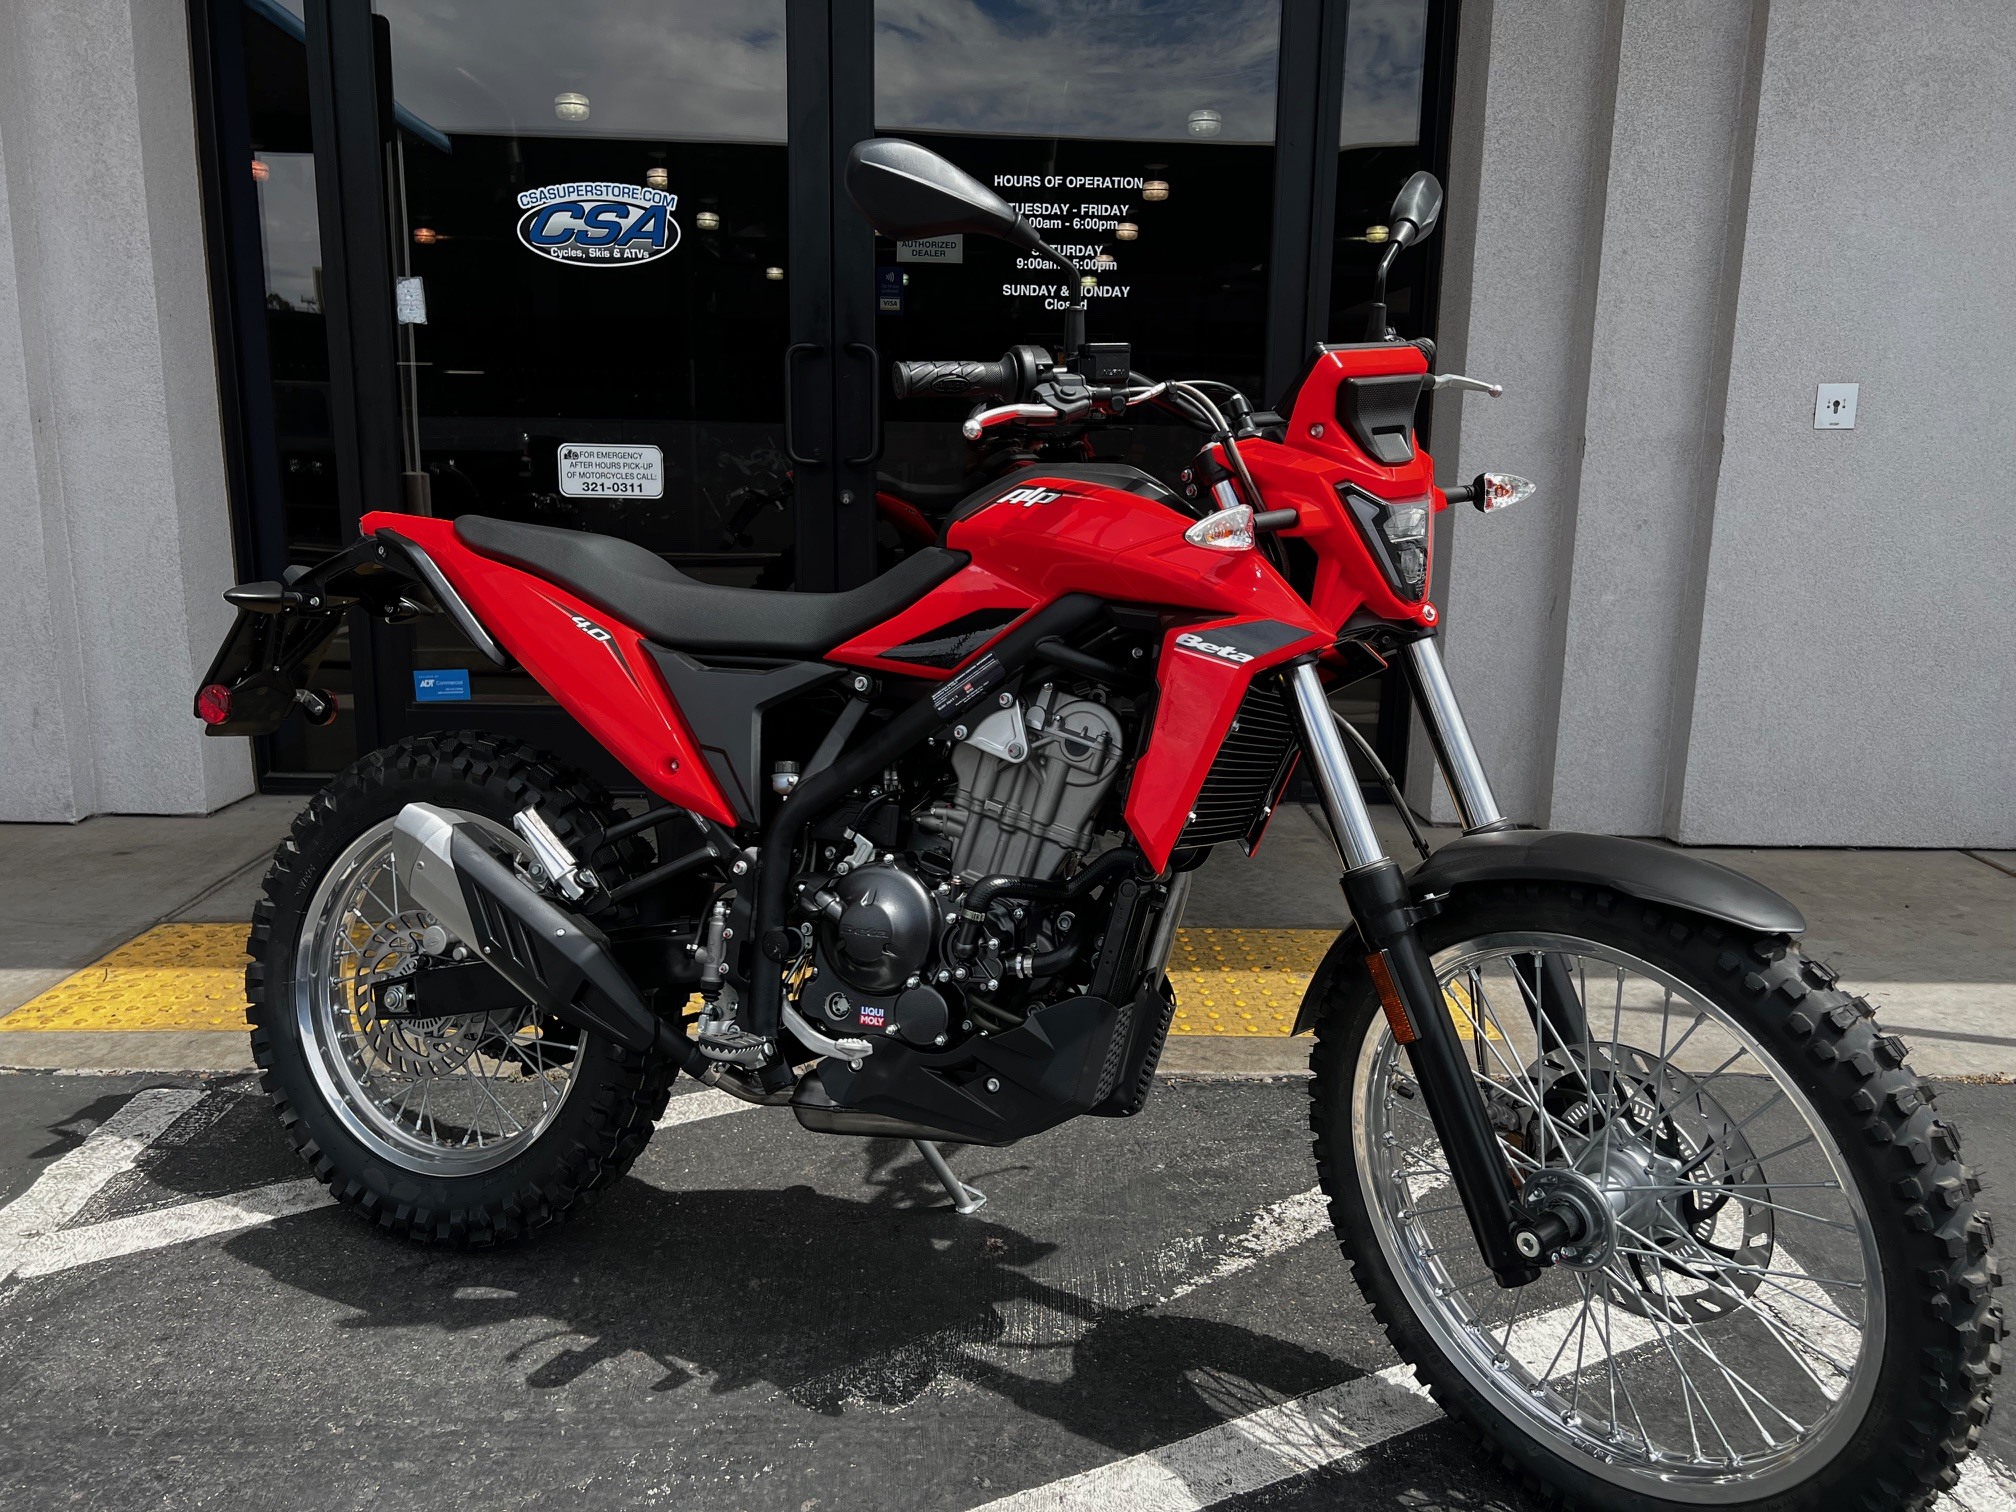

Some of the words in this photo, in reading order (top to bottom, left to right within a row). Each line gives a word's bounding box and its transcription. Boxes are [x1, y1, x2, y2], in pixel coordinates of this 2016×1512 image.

[994, 174, 1041, 187] HOURS
[1044, 175, 1063, 188] OF
[1066, 176, 1144, 189] OPERATION
[519, 183, 677, 209] CSASUPERSTORE.COM
[1080, 204, 1129, 216] FRIDAY
[529, 202, 669, 249] CSA
[1028, 216, 1062, 229] 00am
[1073, 217, 1118, 232] 6:00pm
[901, 240, 957, 249] AUTHORIZED
[550, 247, 586, 259] Cycles,
[588, 248, 610, 258] Skis
[613, 248, 621, 258] &
[624, 248, 650, 259] ATVs
[911, 249, 946, 258] DEALER
[1072, 258, 1118, 273] 5:00pm
[1002, 284, 1057, 296] SUNDAY
[1060, 285, 1070, 297] &
[1080, 285, 1130, 298] ONDAY
[1044, 298, 1088, 311] Closd
[579, 451, 595, 459] FOR
[596, 451, 643, 460] EMERGENCY
[569, 461, 594, 469] AFTER
[595, 461, 621, 470] HOURS
[623, 462, 654, 470] PICK-UP
[566, 471, 577, 479] OF
[578, 471, 635, 480] MOTORCYCLES
[636, 472, 657, 480] CALL:
[582, 481, 643, 493] 321-0311
[571, 616, 612, 641] 4.0
[1175, 632, 1255, 663] Beta
[420, 679, 435, 687] ADT
[861, 1006, 885, 1017] LIQUI
[860, 1015, 885, 1026] MOLY
